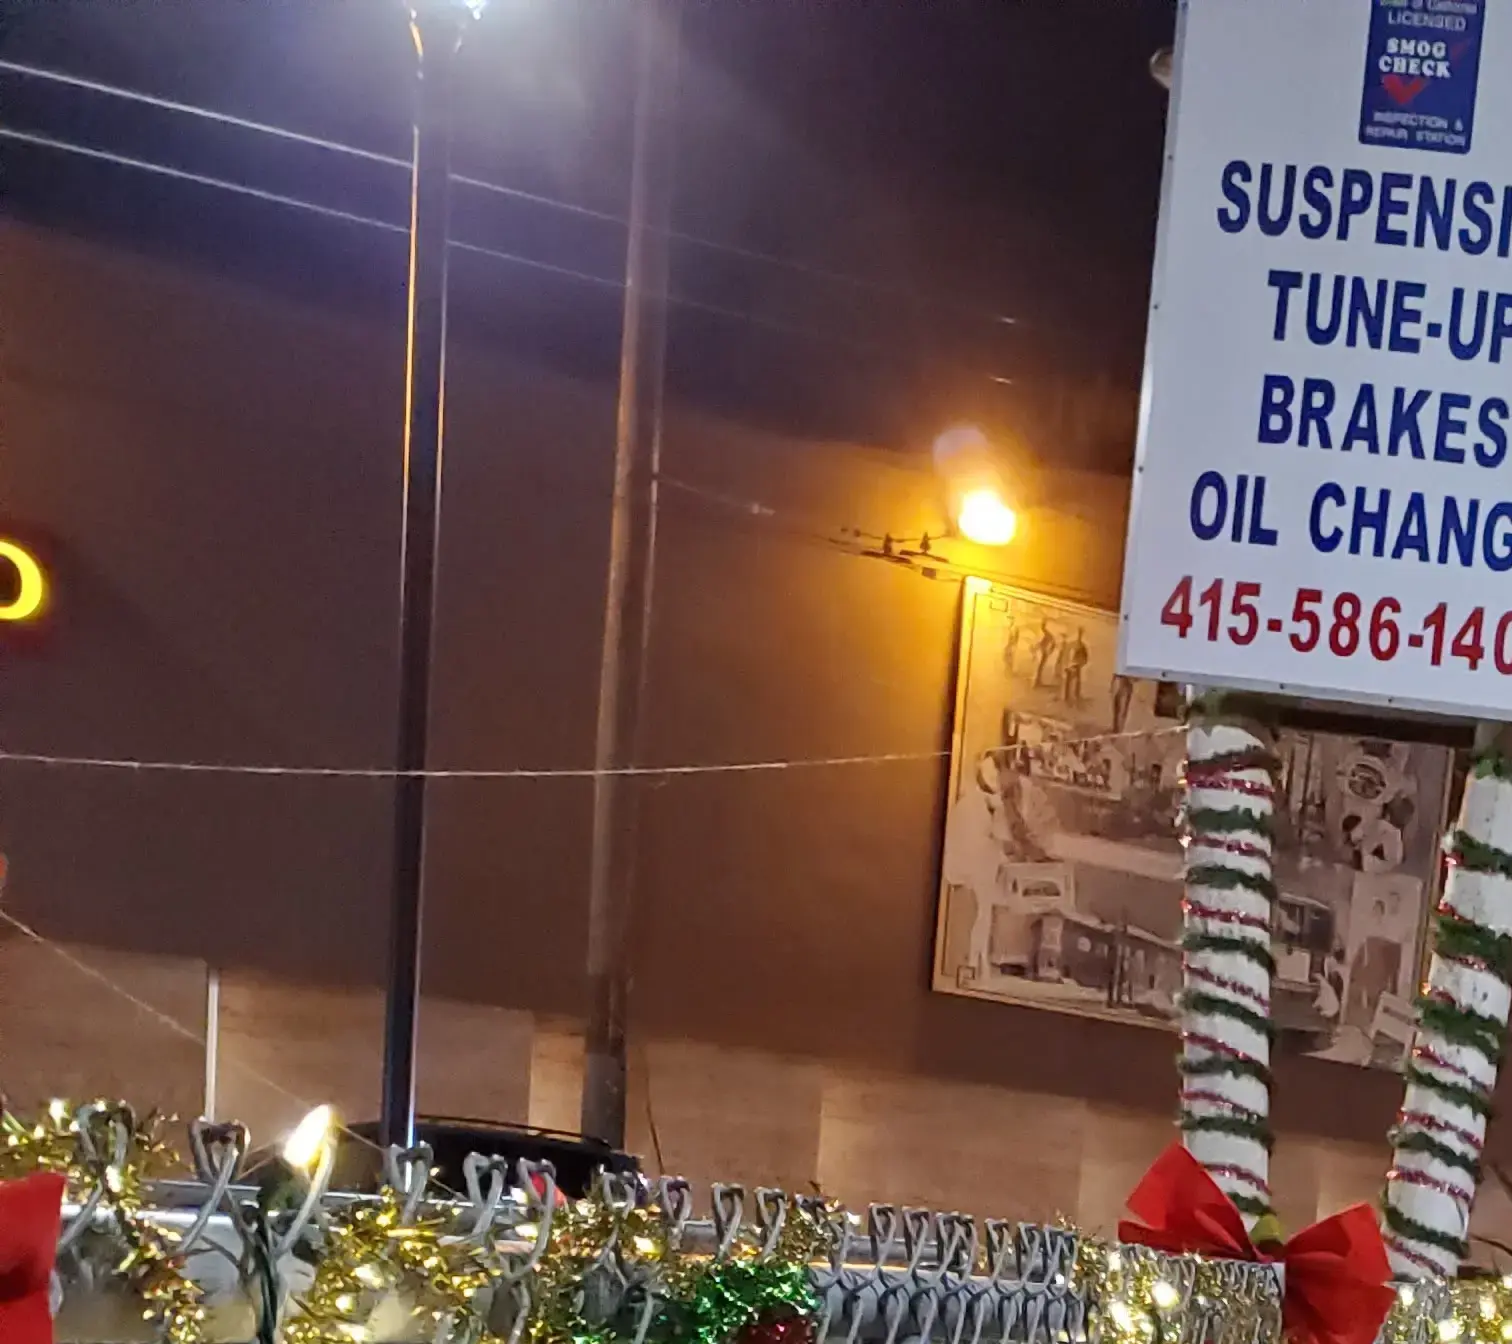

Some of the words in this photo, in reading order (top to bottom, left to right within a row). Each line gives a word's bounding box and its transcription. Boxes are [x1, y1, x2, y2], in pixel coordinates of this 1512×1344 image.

[1378, 55, 1451, 78] CHECK
[1386, 37, 1447, 59] SMOG
[1257, 373, 1510, 469] BRAKES
[1189, 470, 1279, 547] OIL
